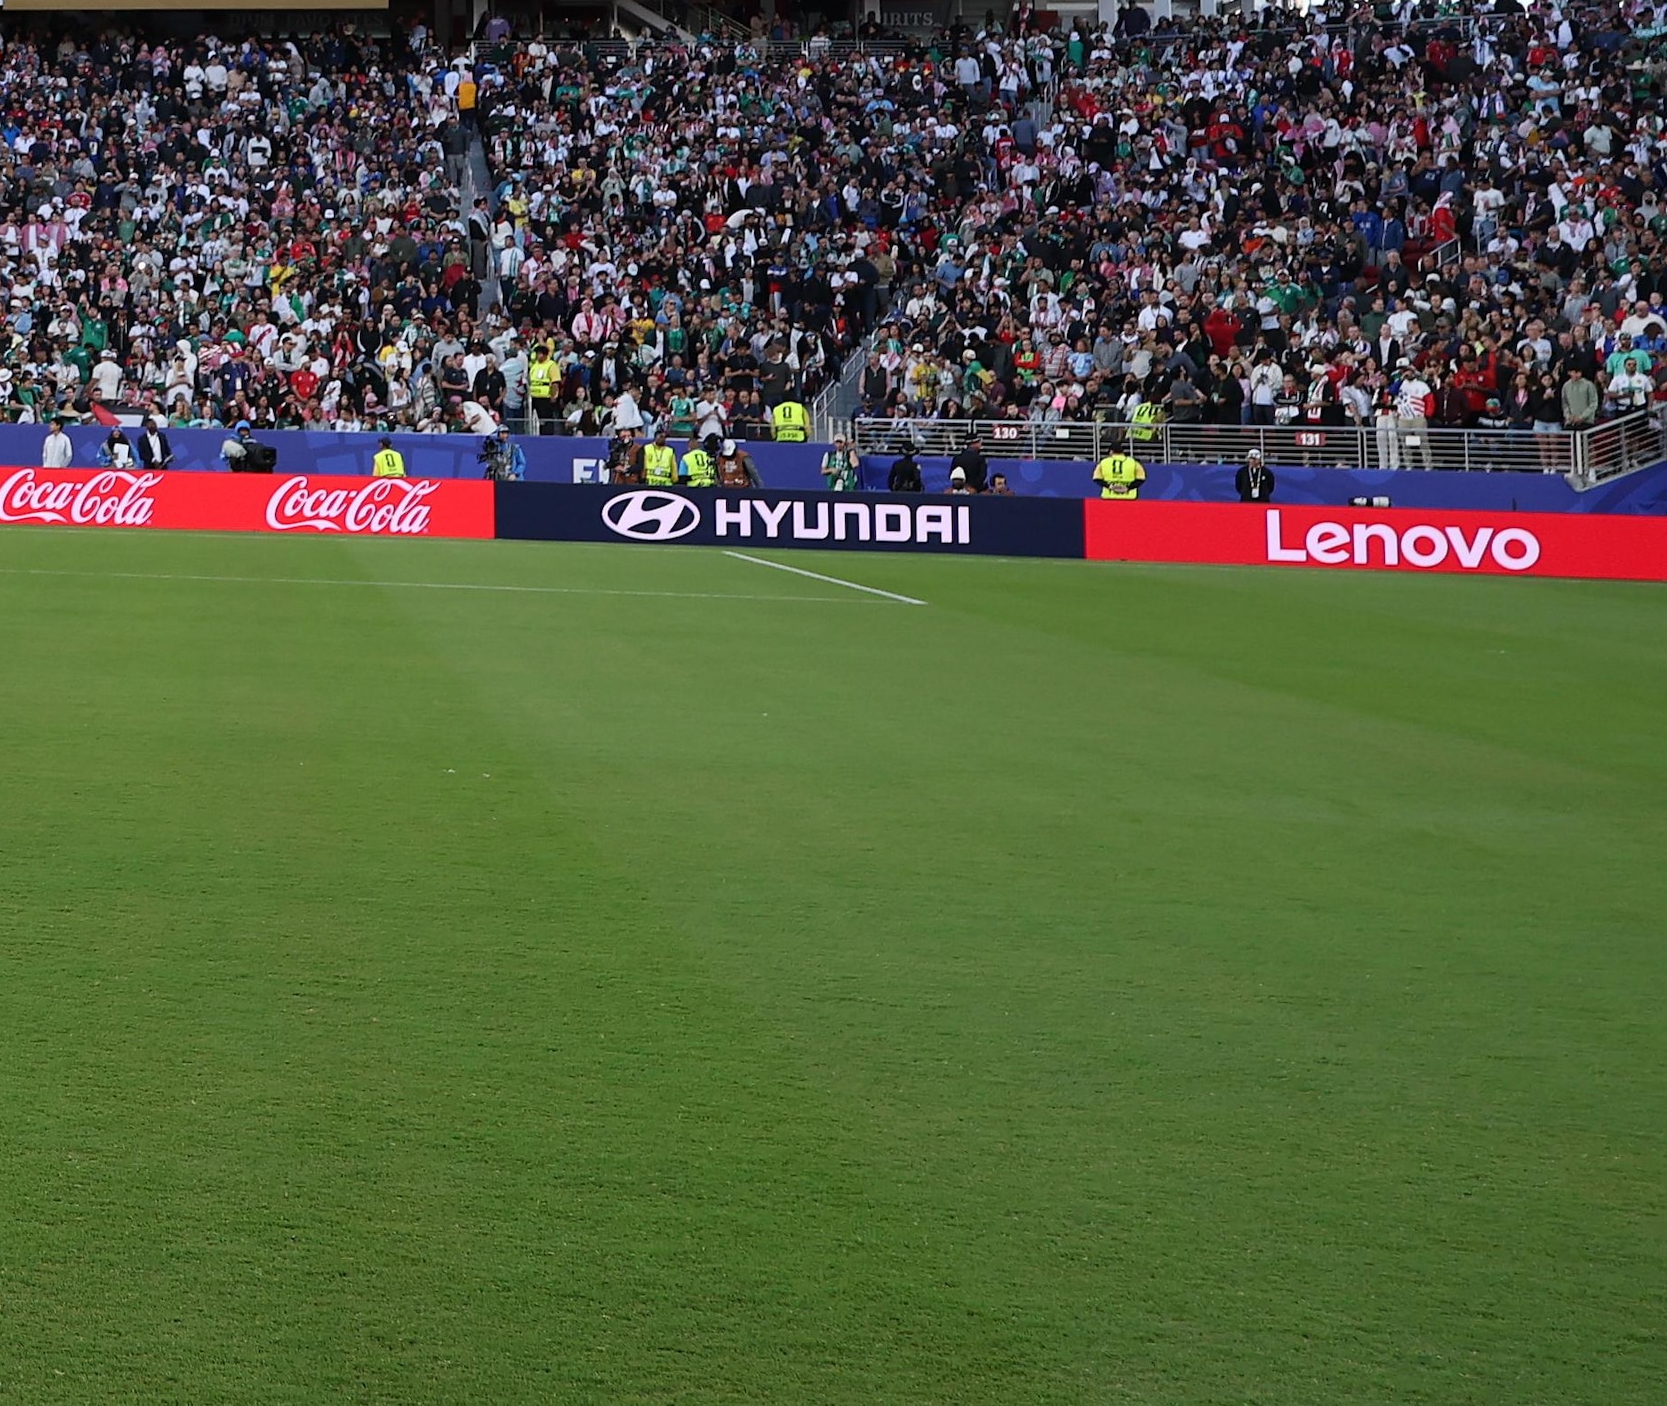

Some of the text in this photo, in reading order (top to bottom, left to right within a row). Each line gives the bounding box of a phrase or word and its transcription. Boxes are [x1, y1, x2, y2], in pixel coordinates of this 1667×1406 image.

[993, 427, 1017, 439] 130
[1300, 434, 1320, 445] 131
[265, 475, 441, 535] Coca-Cola
[715, 498, 971, 544] HYUNDAI
[1267, 510, 1540, 571] Lenovo
